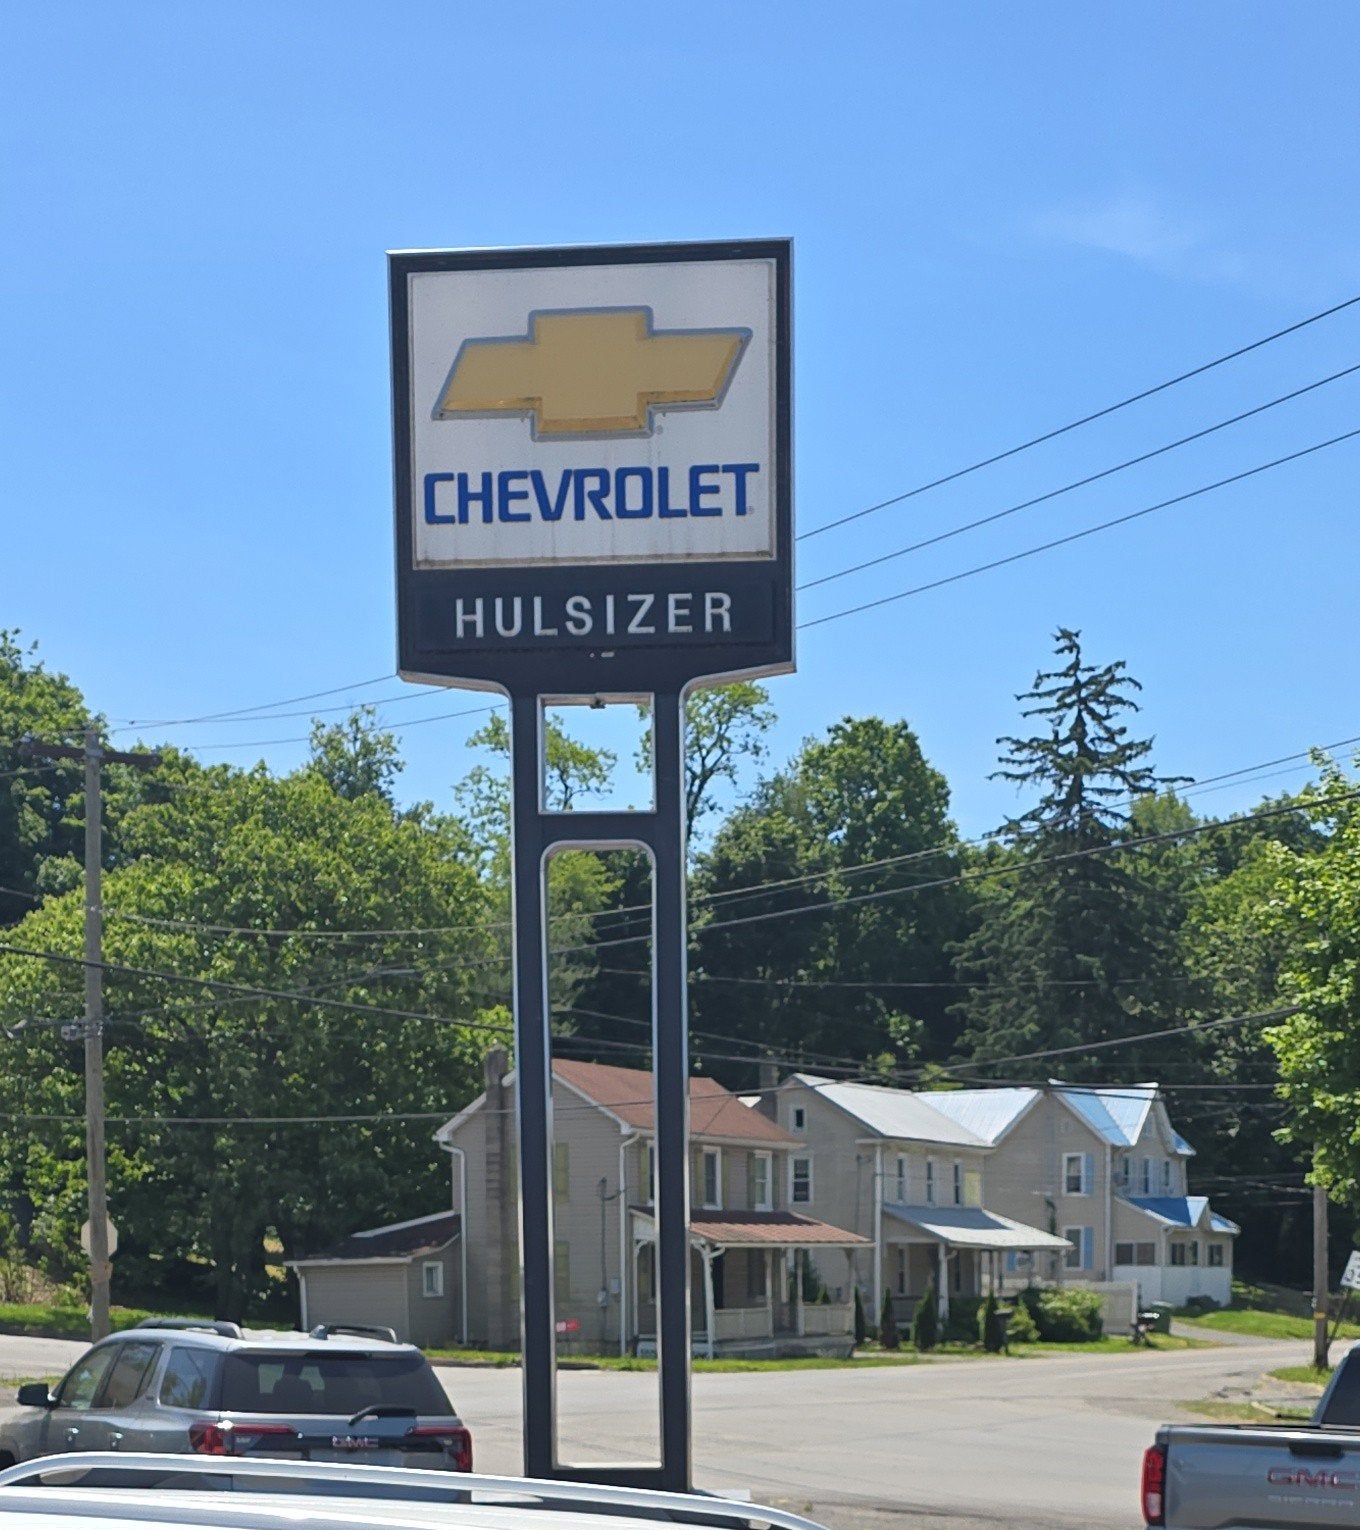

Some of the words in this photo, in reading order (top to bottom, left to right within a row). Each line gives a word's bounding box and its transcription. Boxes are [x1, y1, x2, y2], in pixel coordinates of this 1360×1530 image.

[424, 463, 760, 524] CHEVROLET
[456, 592, 732, 638] HULSIZER
[332, 1435, 378, 1448] GMC
[1267, 1467, 1360, 1491] GMC
